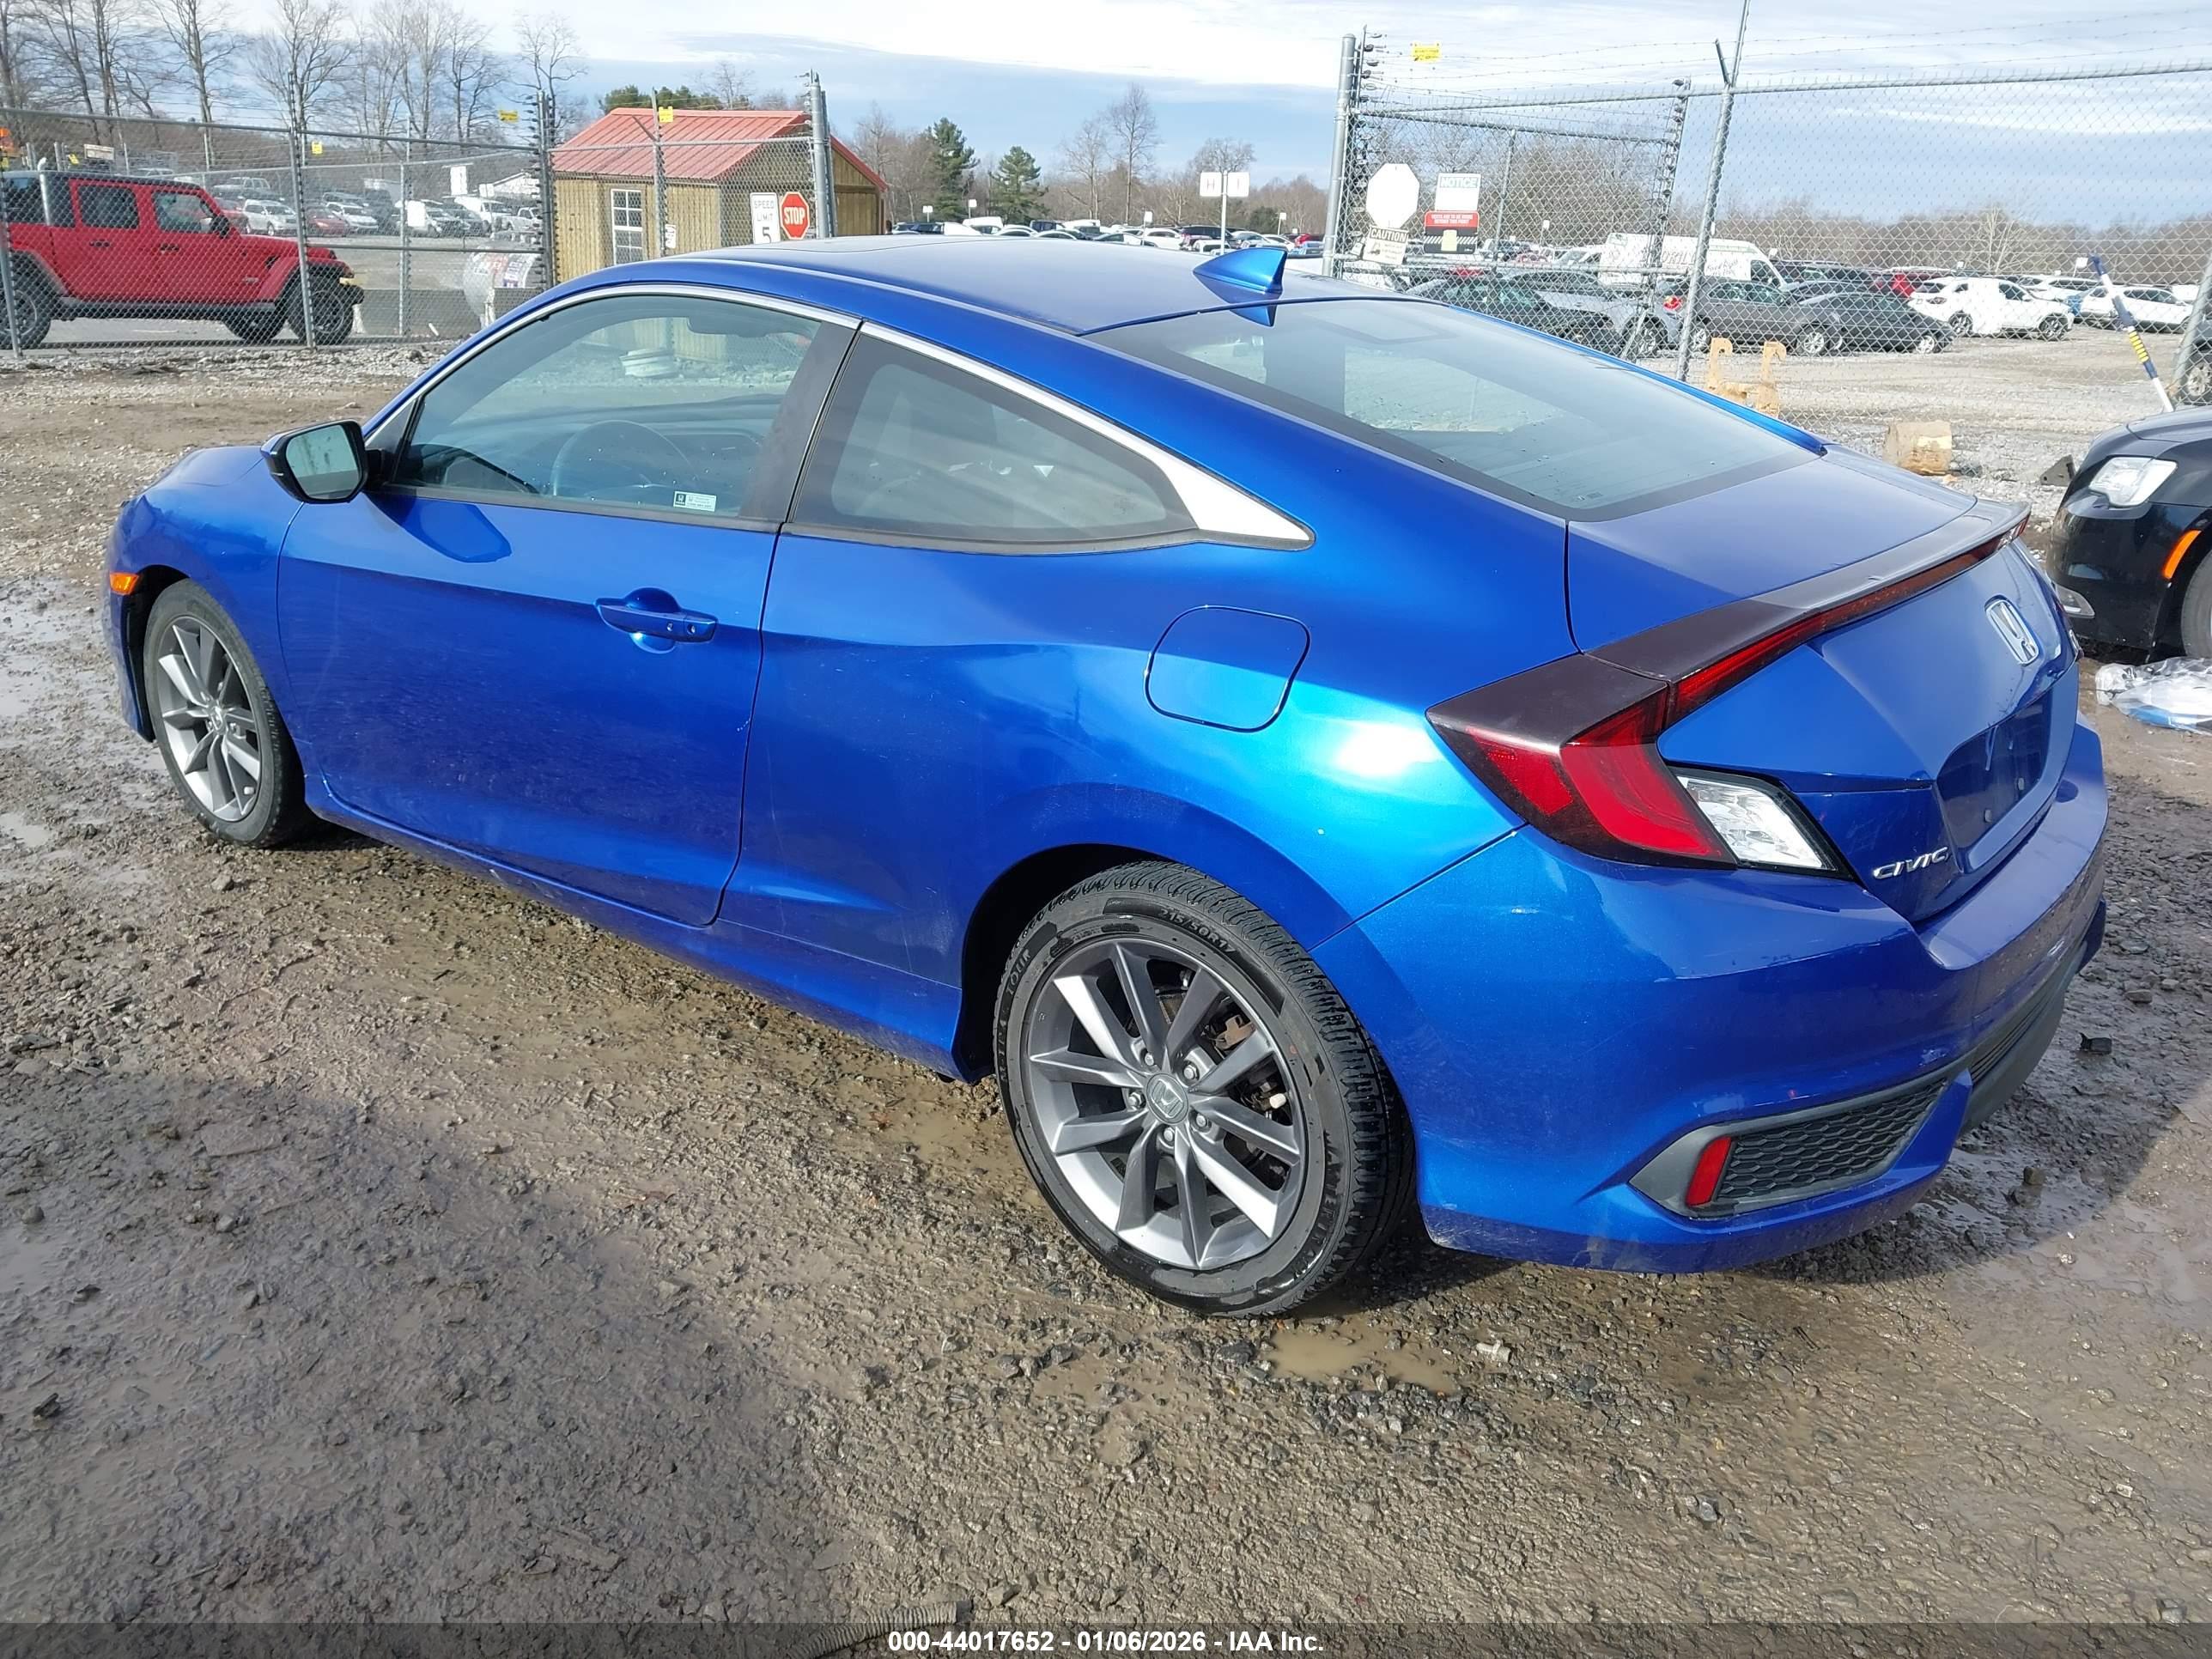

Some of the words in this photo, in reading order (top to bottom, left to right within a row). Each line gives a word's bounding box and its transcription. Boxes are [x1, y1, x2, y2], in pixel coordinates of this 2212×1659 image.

[1440, 177, 1477, 188] NOTICE
[754, 200, 775, 209] SPEED
[757, 212, 774, 222] LIMIT
[783, 207, 806, 225] STOP
[762, 227, 772, 243] 5
[1370, 228, 1407, 243] CAUTION
[1873, 847, 1949, 879] CIVIC
[1159, 908, 1237, 952] 215/50R17
[1006, 948, 1031, 996] TOUR
